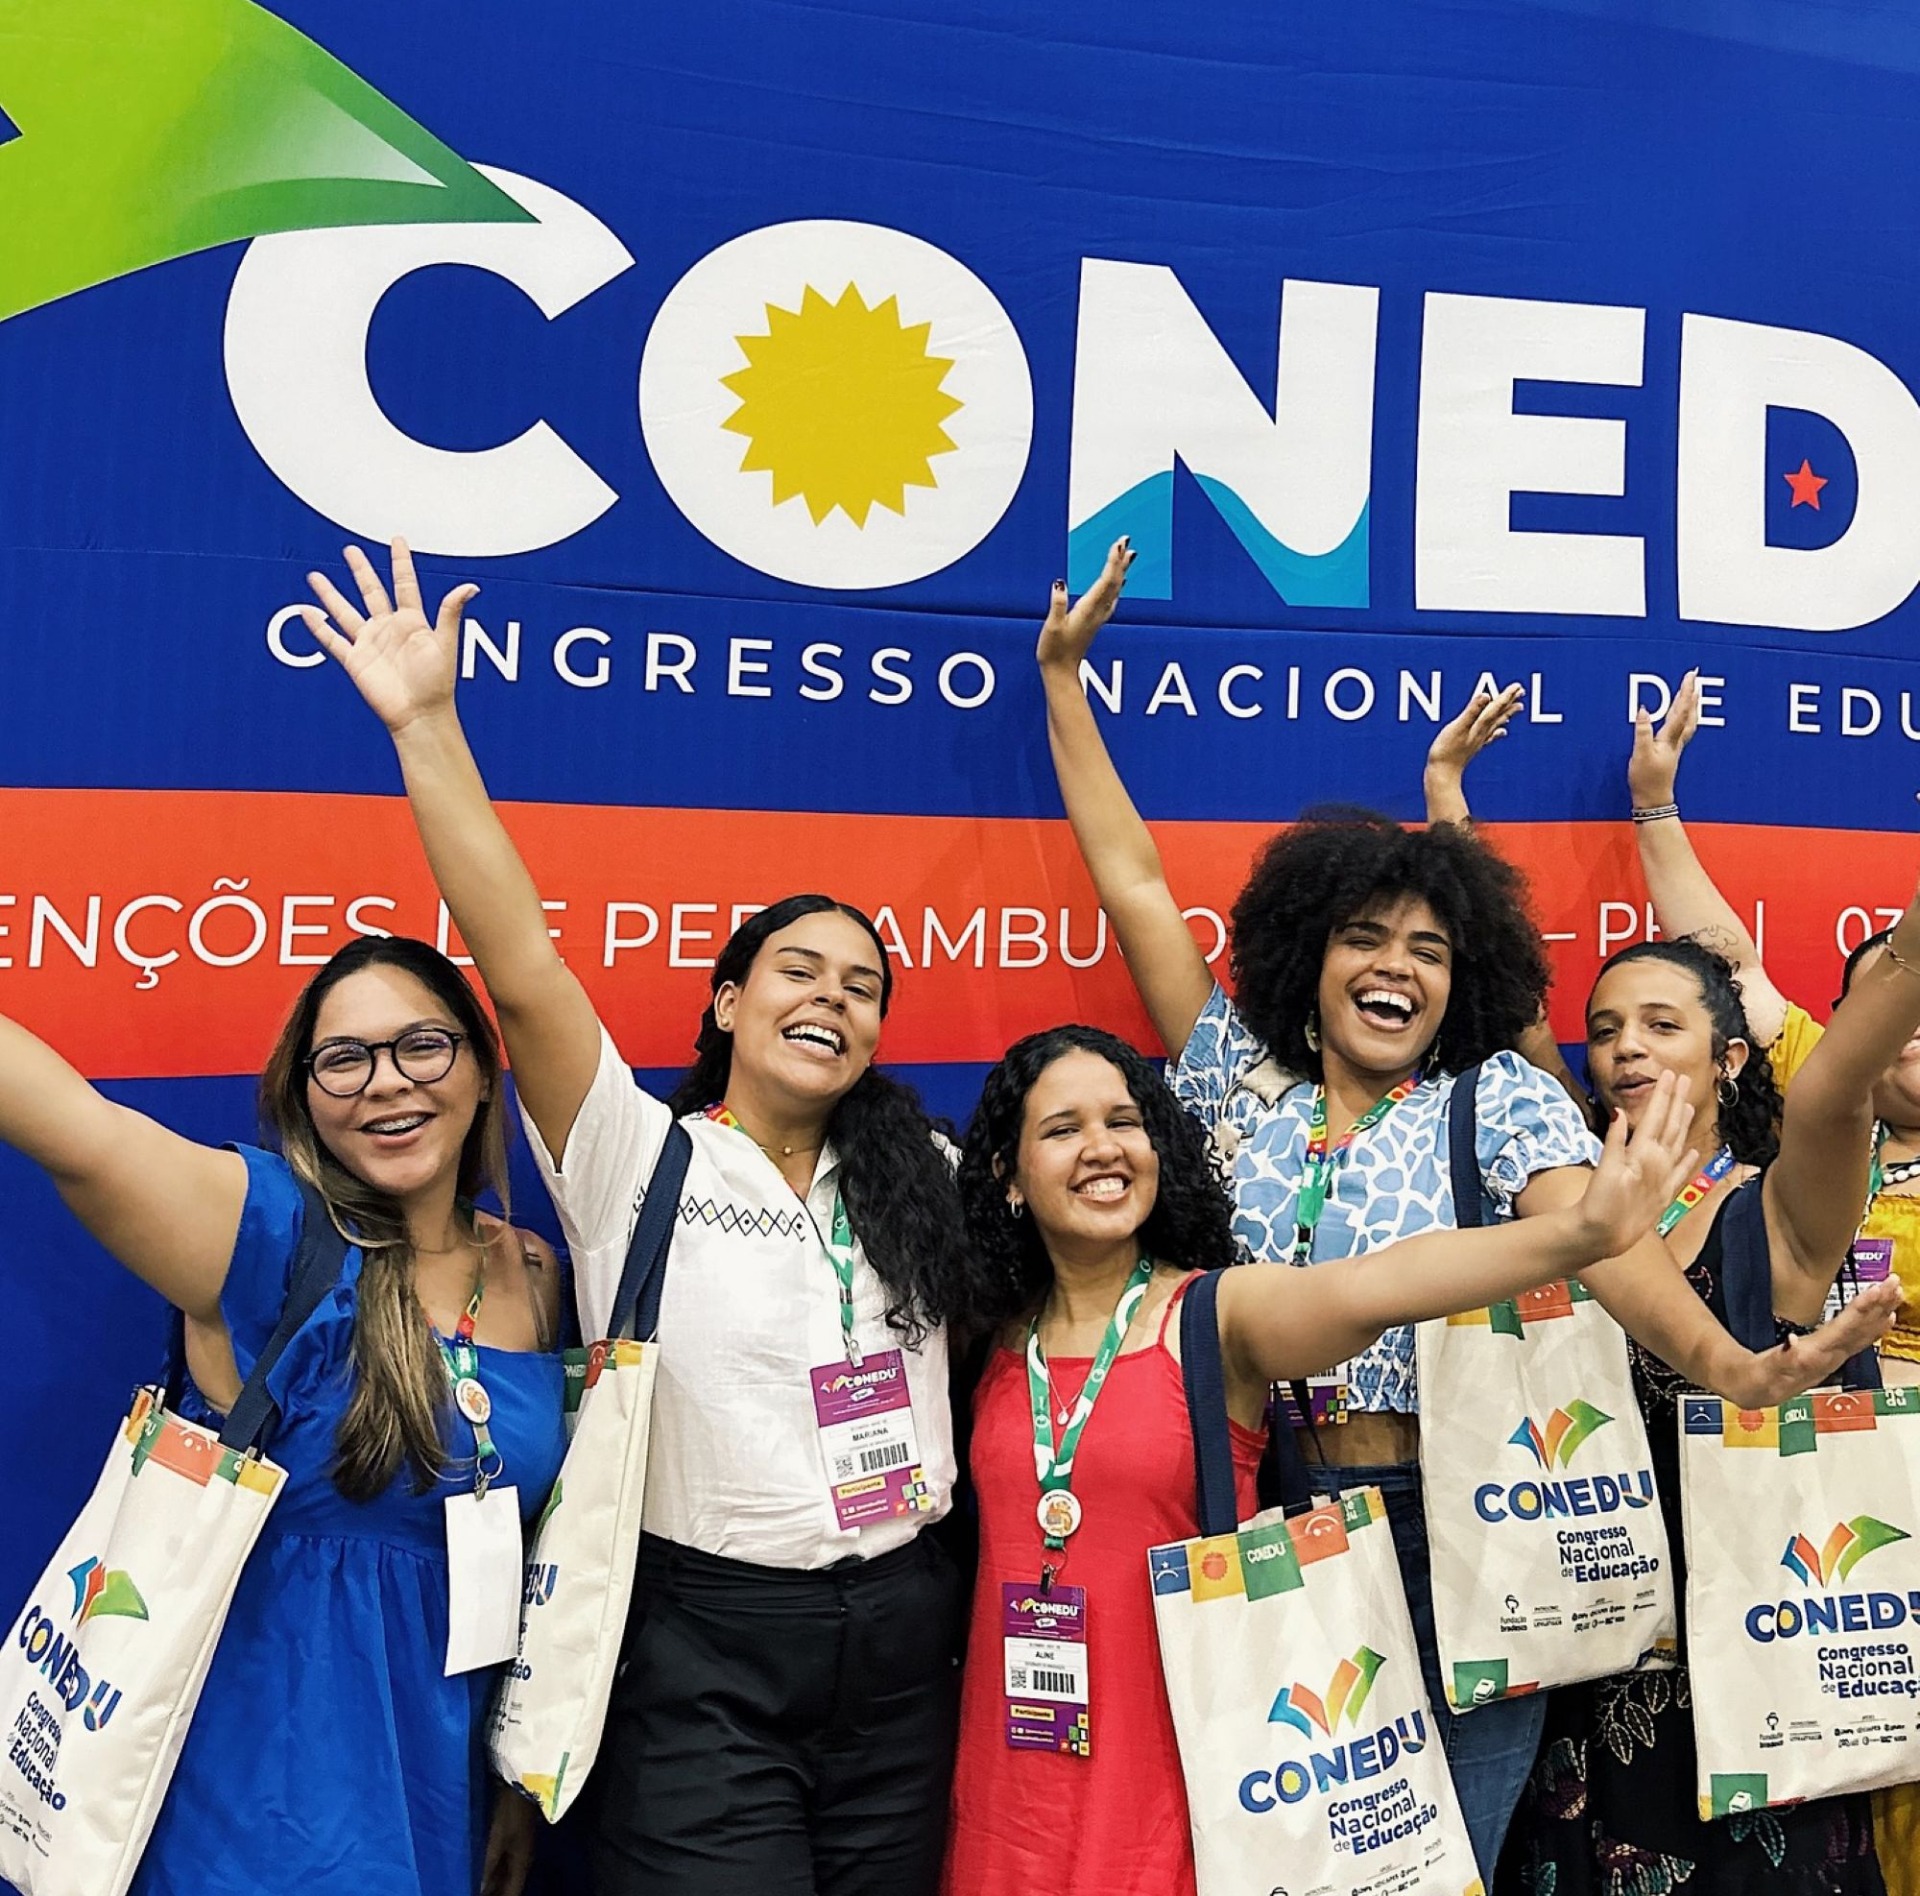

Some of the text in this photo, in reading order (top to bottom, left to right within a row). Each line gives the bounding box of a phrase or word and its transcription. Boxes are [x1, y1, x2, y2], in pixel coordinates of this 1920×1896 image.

[266, 604, 997, 709] CNGRESSO
[1628, 673, 1725, 727] DE
[1474, 1469, 1654, 1523] CONEDU
[1557, 1526, 1628, 1546] Congresso
[1560, 1537, 1634, 1565] Nacional
[1561, 1555, 1660, 1583] de Educação
[1033, 1602, 1079, 1617] CONEDU
[1745, 1591, 1920, 1643] CONED
[1817, 1643, 1909, 1662] Congresso
[1818, 1656, 1914, 1681] Nacional
[1821, 1682, 1836, 1693] de
[1238, 1709, 1427, 1814] CONEDU
[1328, 1778, 1408, 1818] Congresso
[1330, 1789, 1416, 1839] Nacional
[1333, 1841, 1350, 1853] de
[1351, 1803, 1438, 1855] Educação
